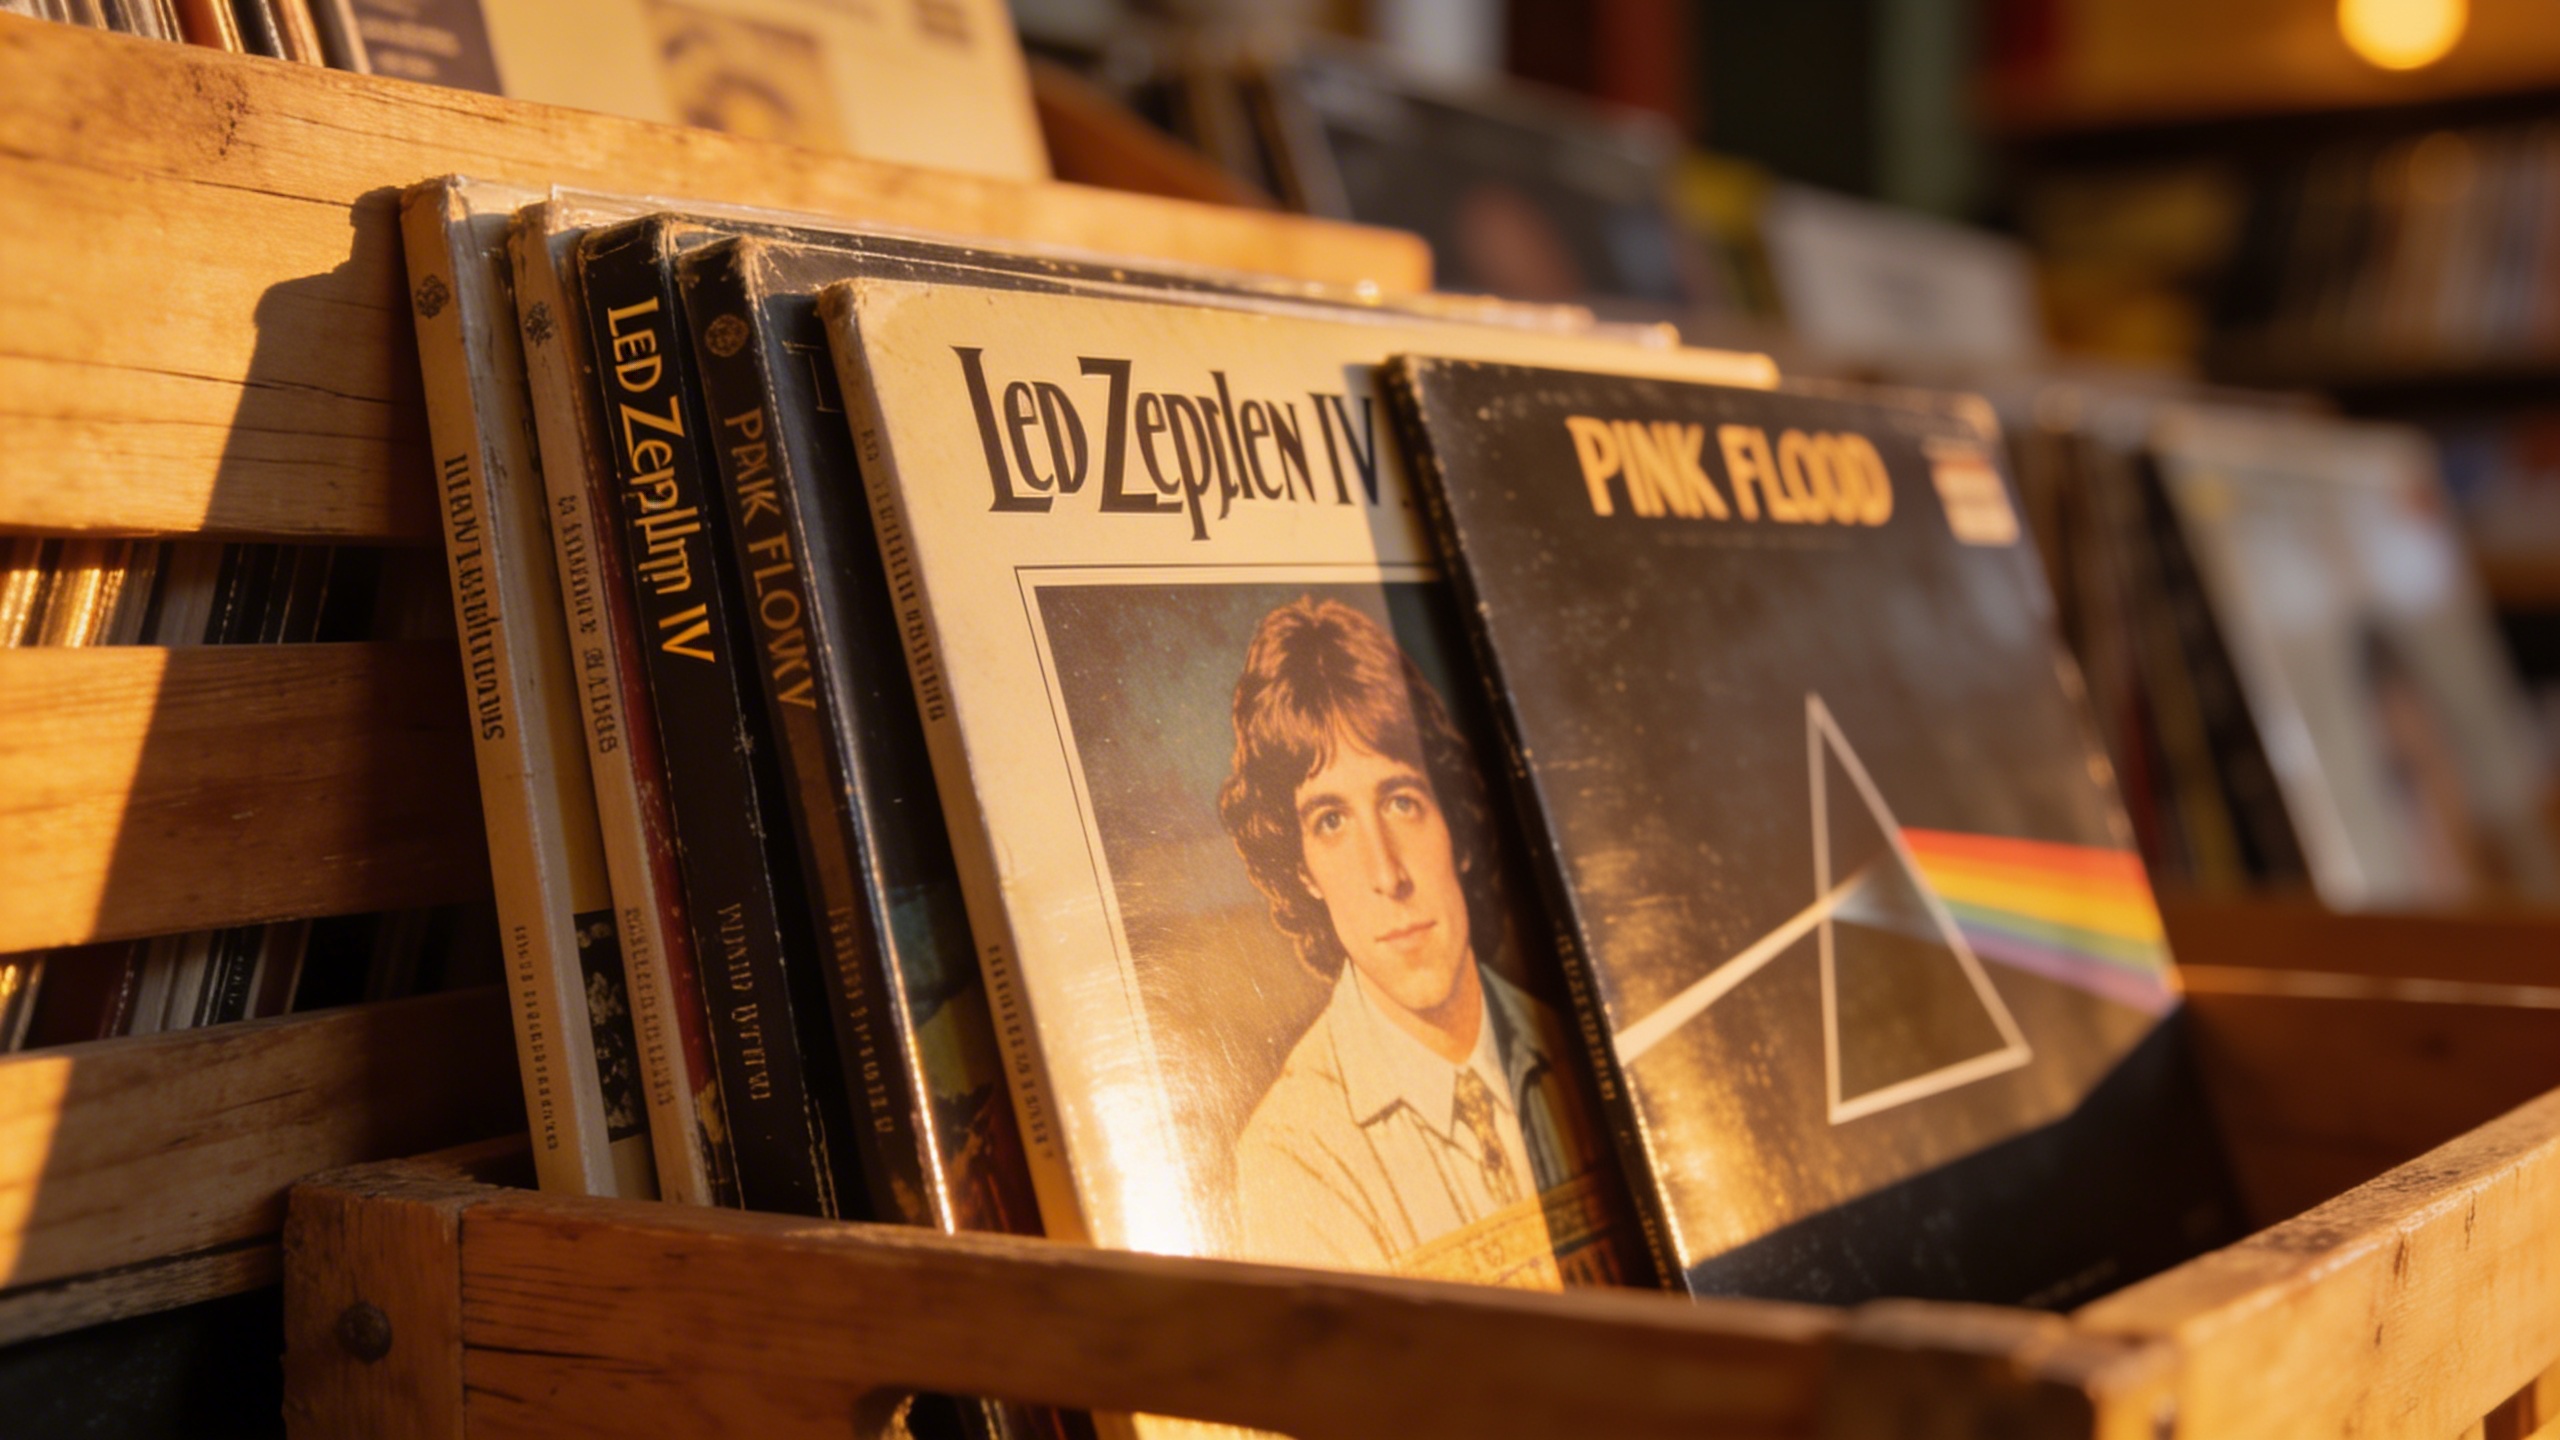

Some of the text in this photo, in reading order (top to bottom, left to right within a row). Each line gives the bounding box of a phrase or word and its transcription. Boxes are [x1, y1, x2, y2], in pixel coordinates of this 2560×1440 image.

[607, 297, 663, 392] LED
[659, 603, 716, 663] IV
[1307, 392, 1379, 506] IV
[1565, 415, 1730, 521] PINK
